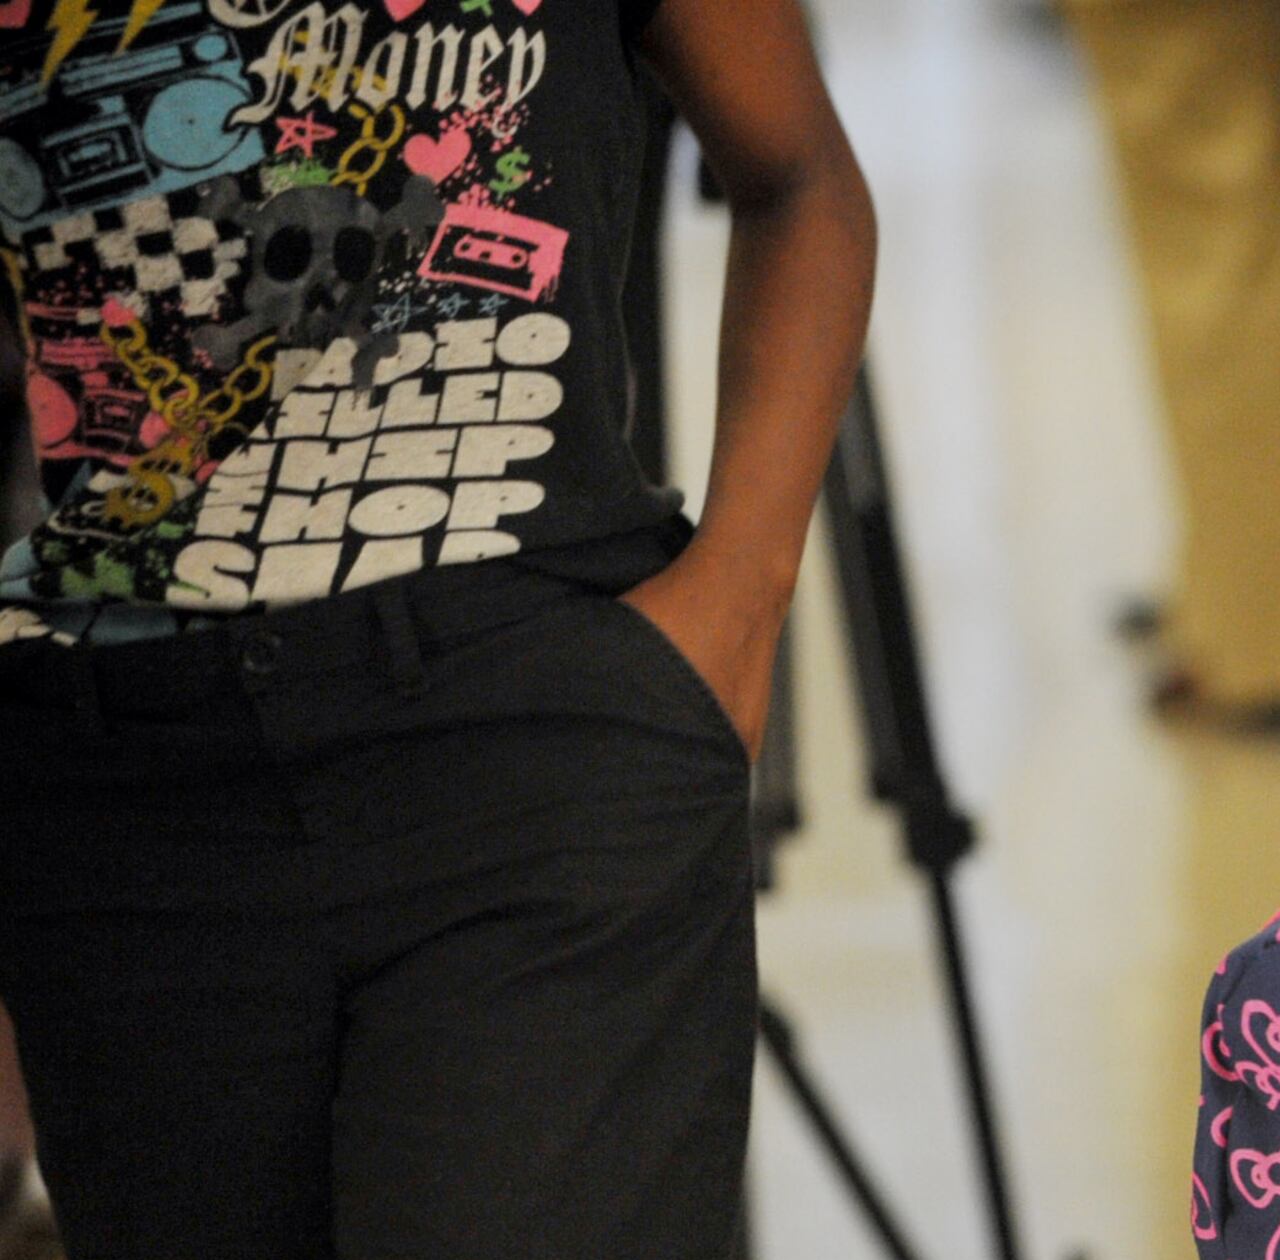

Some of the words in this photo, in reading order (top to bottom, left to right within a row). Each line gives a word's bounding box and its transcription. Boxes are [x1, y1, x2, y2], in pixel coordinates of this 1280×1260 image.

[229, 1, 547, 139] Money
[277, 425, 554, 491] HIP
[258, 480, 545, 542] HOP
